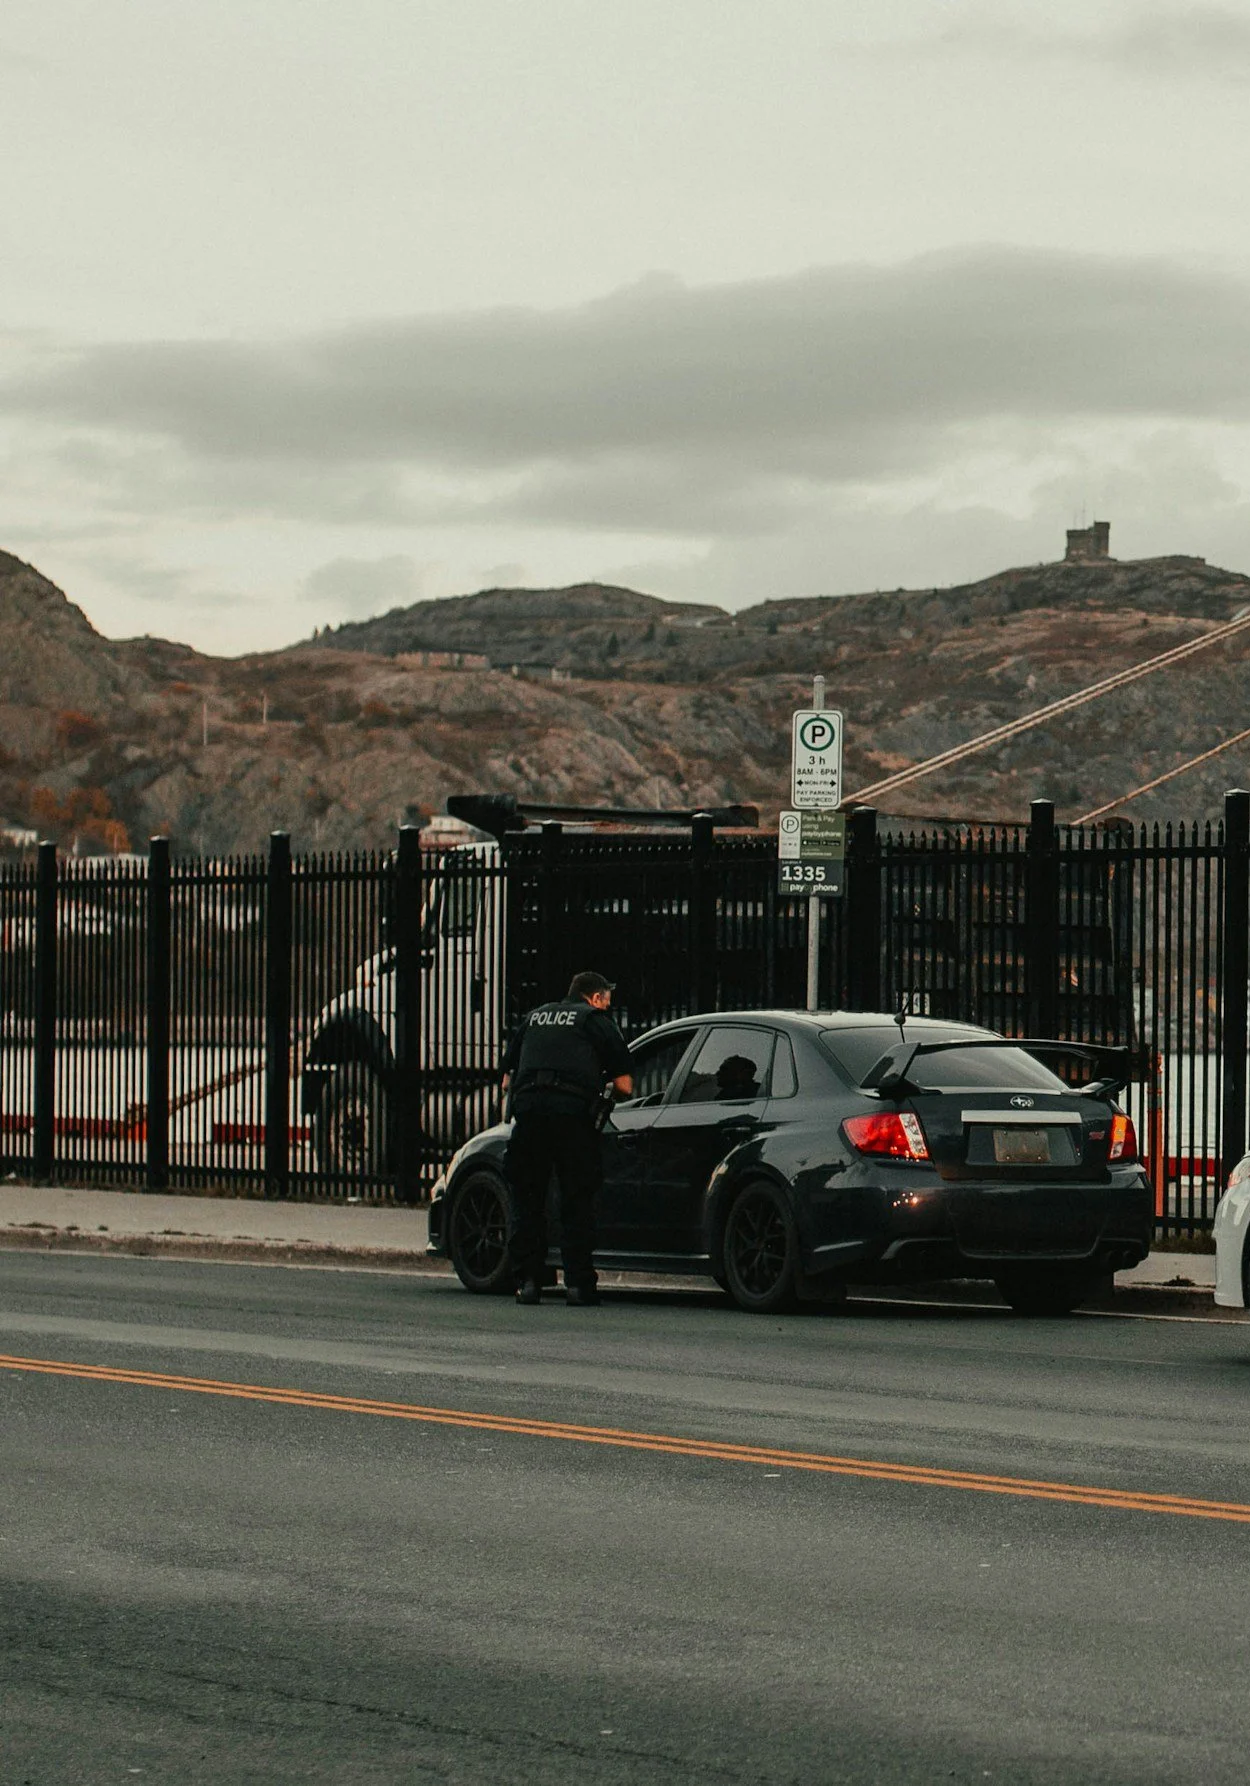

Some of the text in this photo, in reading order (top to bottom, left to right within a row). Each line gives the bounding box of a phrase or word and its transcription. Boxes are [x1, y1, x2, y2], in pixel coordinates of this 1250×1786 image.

[811, 725, 826, 744] P
[809, 755, 826, 765] 3 h
[796, 767, 814, 776] 8AM
[820, 767, 837, 776] 6PM
[823, 815, 836, 823] Pay
[782, 865, 826, 882] 1335
[529, 1011, 578, 1027] POLICE
